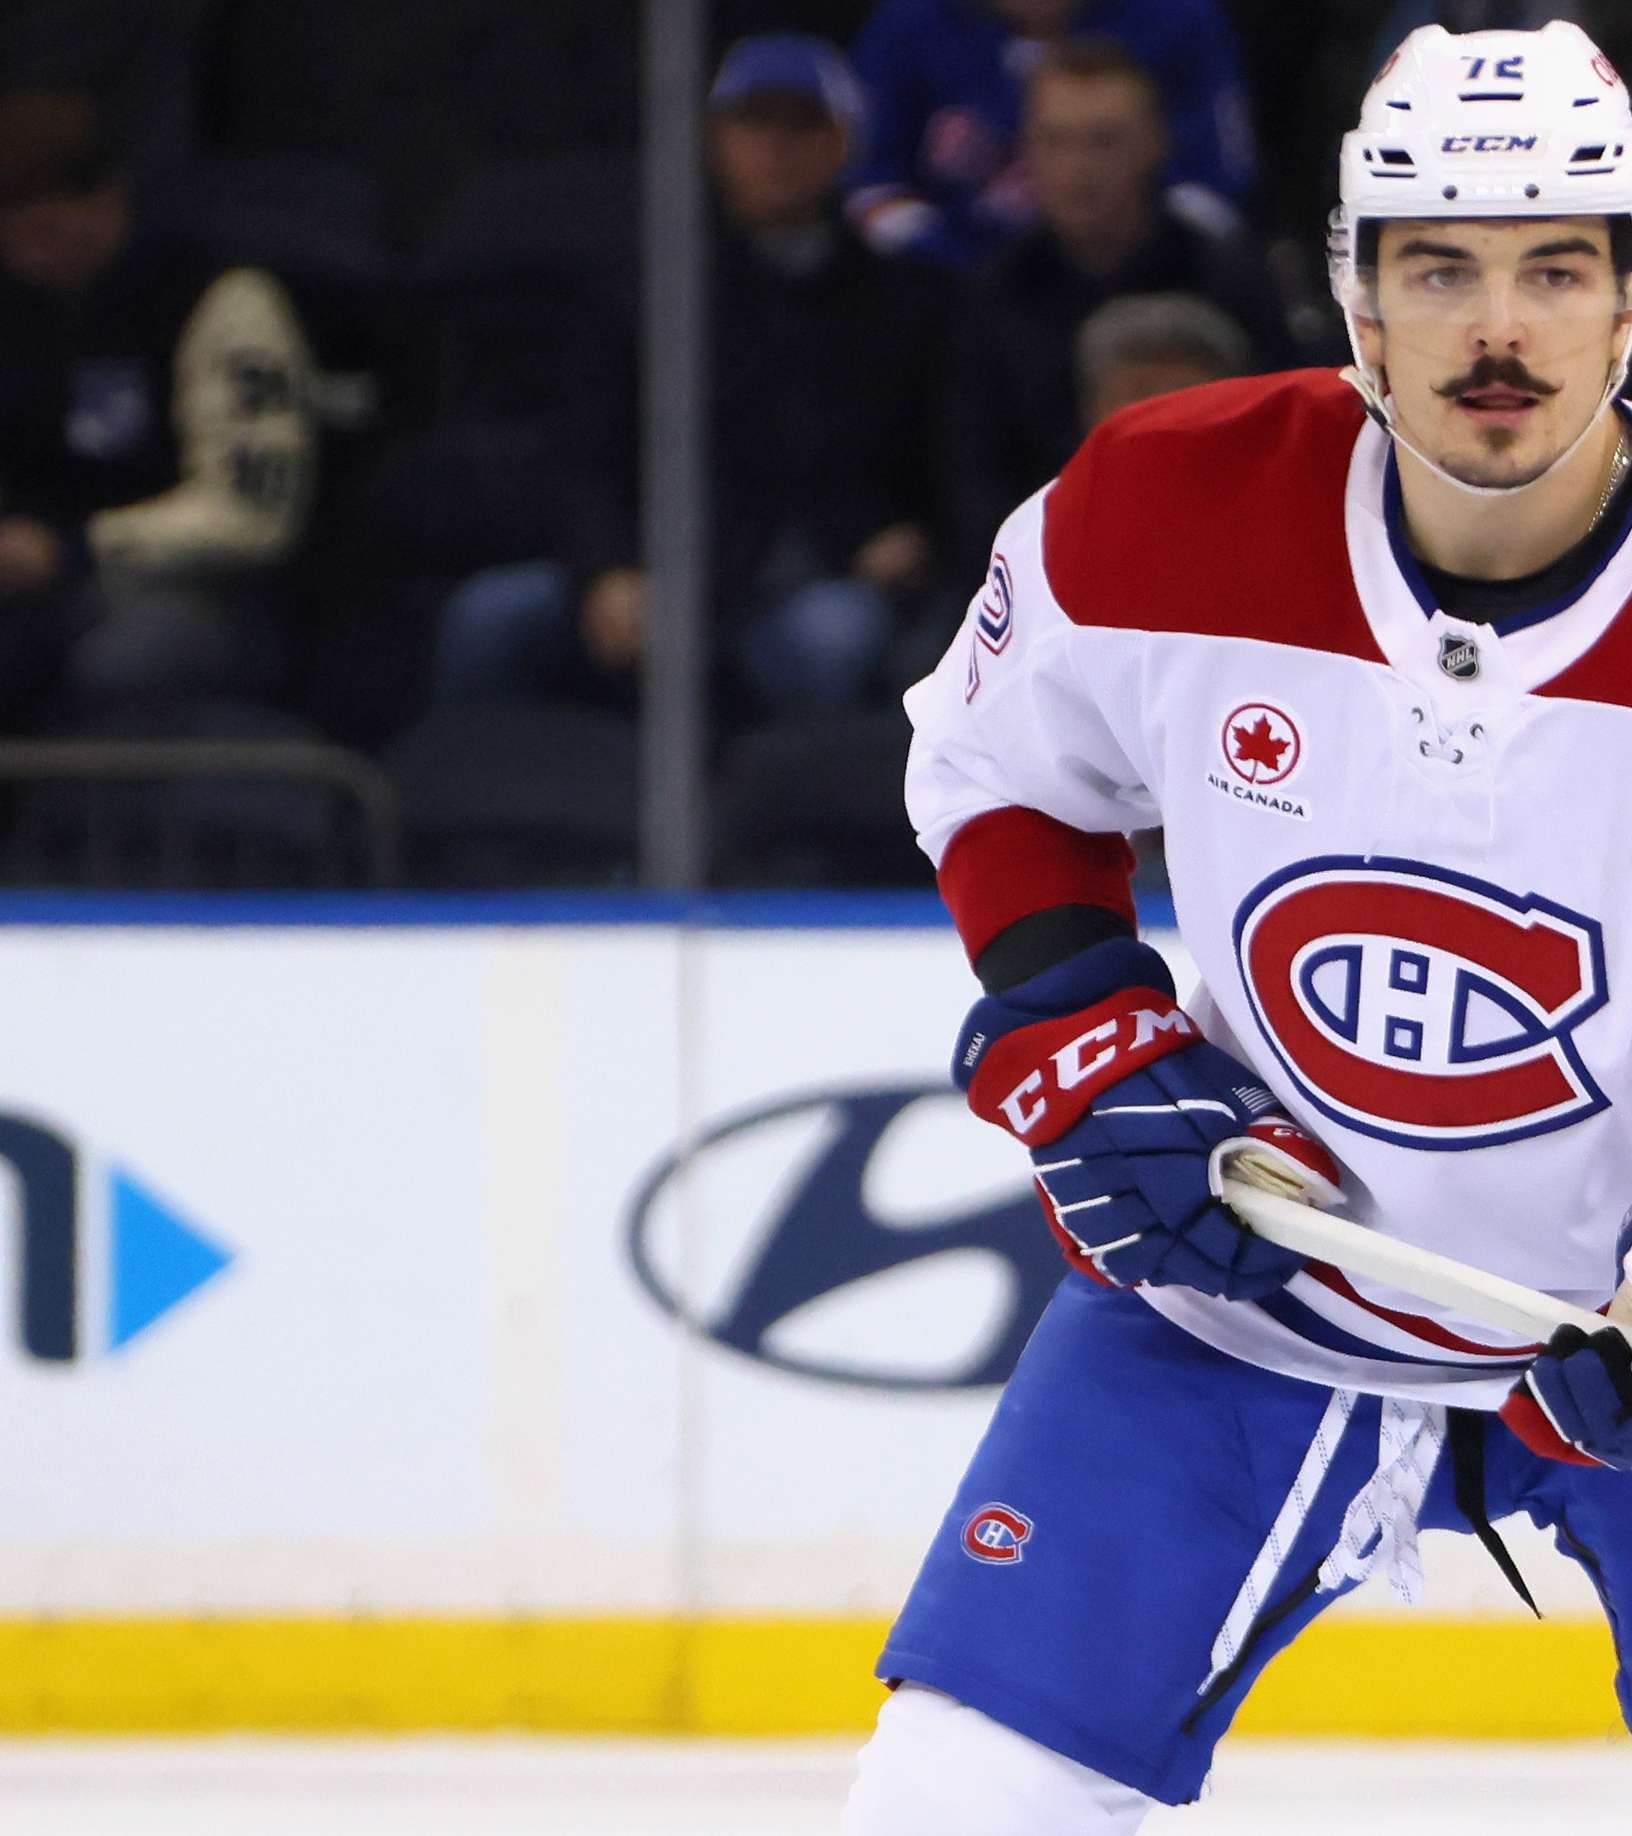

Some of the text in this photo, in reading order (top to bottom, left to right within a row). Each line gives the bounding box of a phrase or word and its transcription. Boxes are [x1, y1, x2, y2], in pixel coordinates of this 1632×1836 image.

[1460, 55, 1524, 80] 72
[1440, 135, 1538, 153] CCM
[1208, 773, 1305, 817] AIR CANADA
[997, 1008, 1192, 1135] CCM
